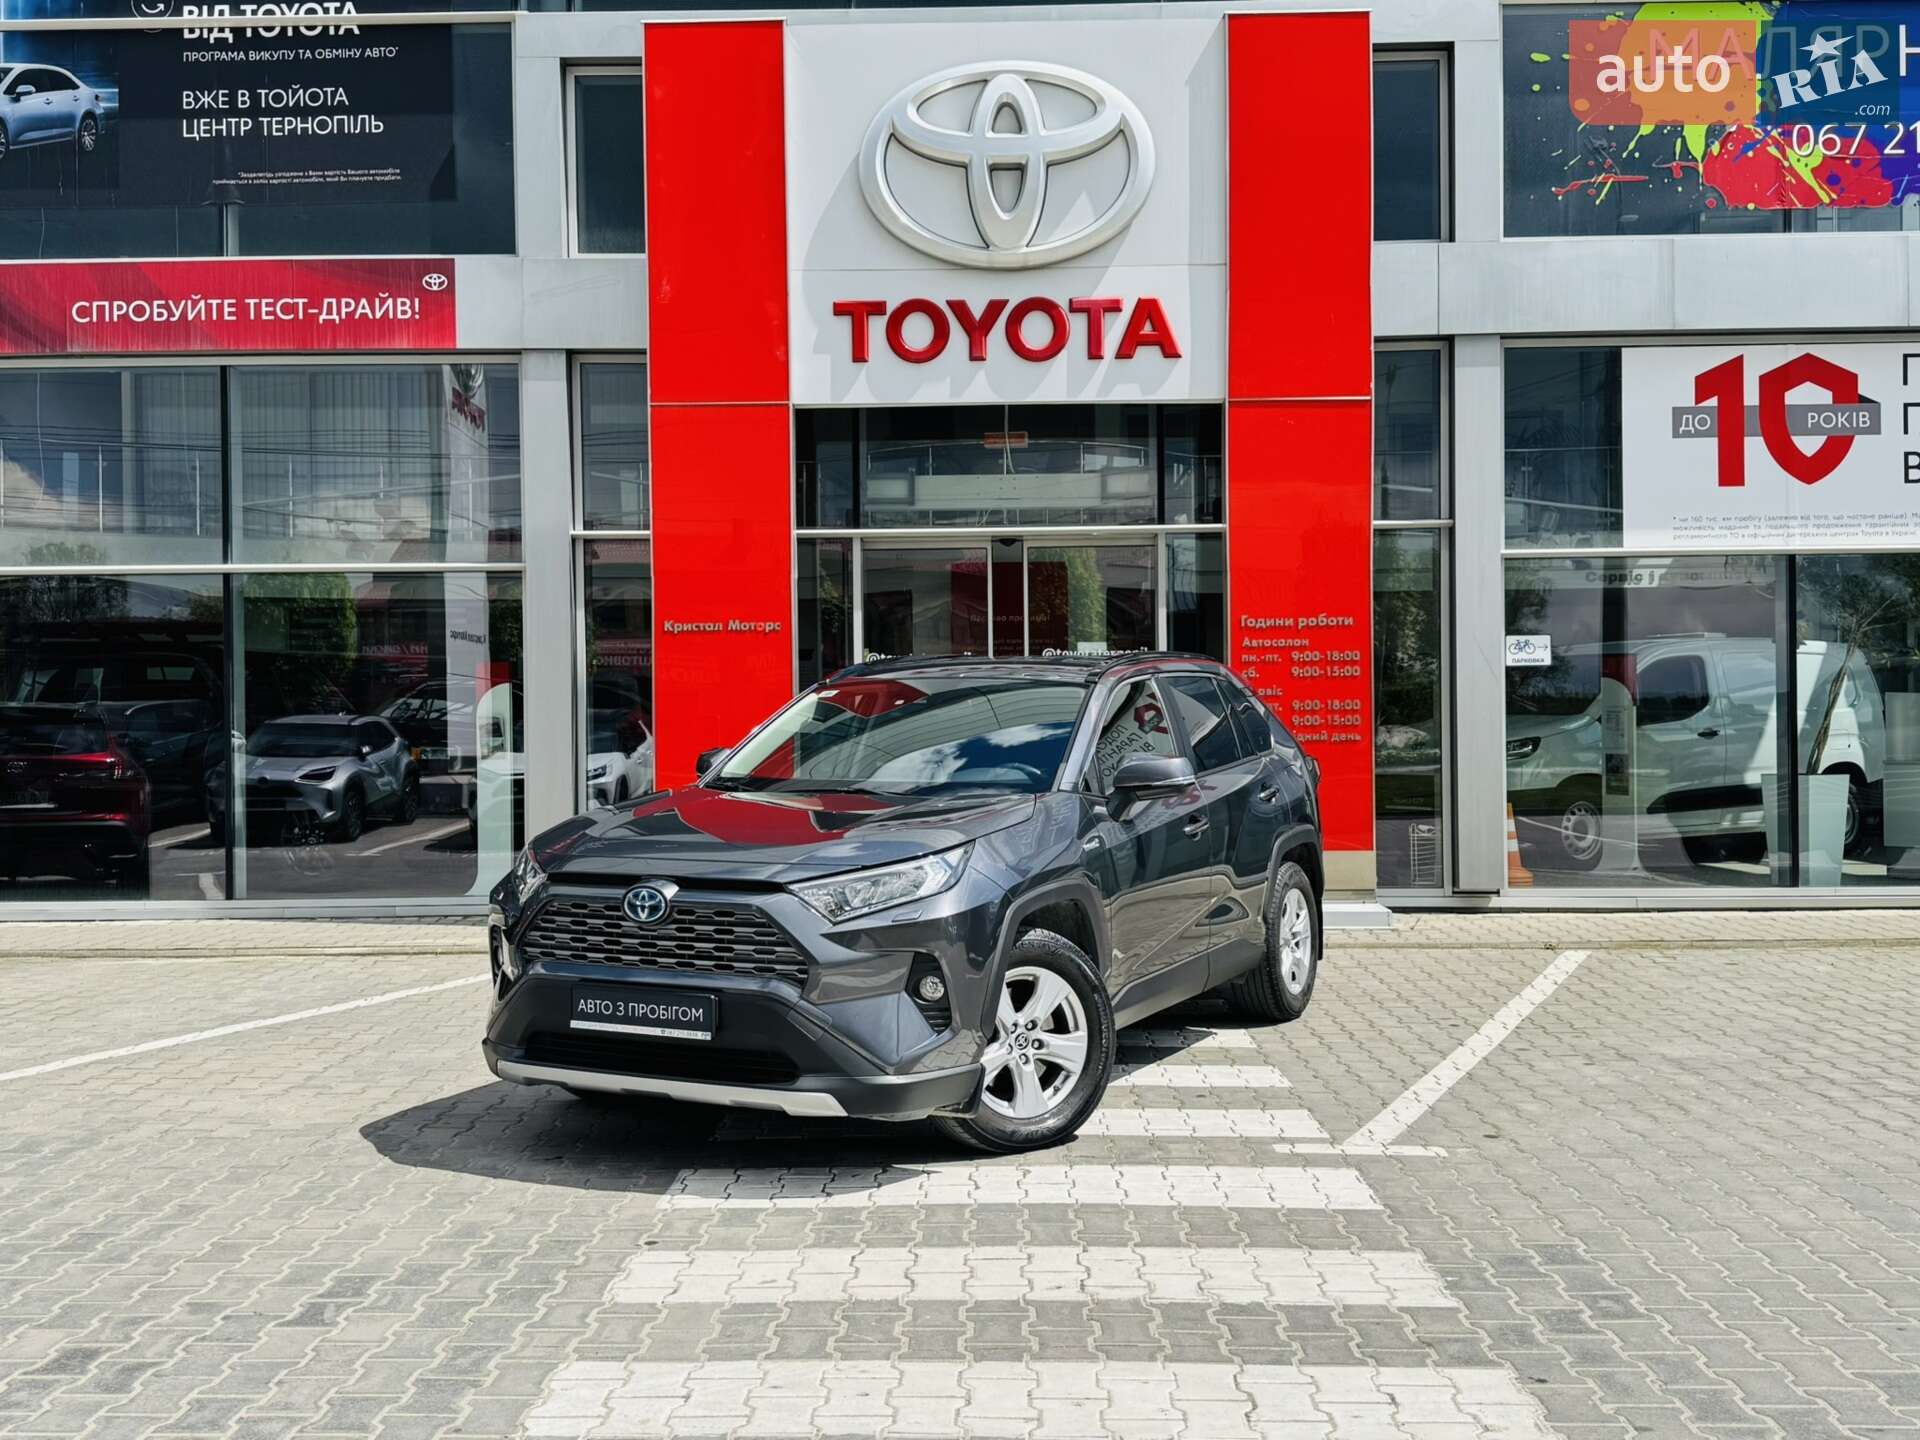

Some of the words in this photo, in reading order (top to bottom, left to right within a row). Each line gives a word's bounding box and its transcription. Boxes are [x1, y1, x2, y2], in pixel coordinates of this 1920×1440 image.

[182, 5, 233, 43] ВІД
[240, 2, 360, 37] TOYOTA
[183, 51, 246, 62] ПРОГРАМА
[249, 50, 296, 61] ВИКУПУ
[299, 49, 312, 60] ТА
[315, 48, 361, 59] ОБМІНУ
[183, 90, 229, 109] ВЖЕ
[238, 89, 250, 108] В
[257, 84, 349, 108] ТОЙОТА
[183, 118, 252, 141] ЦЕНТР
[259, 115, 384, 136] ТЕРНОПІЛЬ
[1792, 122, 1868, 156] 067
[72, 294, 237, 323] СПРОБУЙТЕ
[245, 292, 421, 324] ТЕСТ-ДРАЙВ!
[833, 297, 1182, 363] TOYOTA
[1679, 414, 1711, 433] ДО
[1695, 352, 1860, 487] 10
[1807, 412, 1871, 429] РОКІВ
[664, 620, 723, 634] Кристал
[728, 619, 782, 633] Моторс
[1240, 615, 1294, 628] Години
[1298, 613, 1354, 630] роботи
[1242, 636, 1310, 648] Автосалон
[1291, 650, 1361, 662] 9:00-18:00
[1291, 666, 1361, 677] 9:00-15:00
[1291, 700, 1361, 711] 9:00-18:00
[1291, 715, 1361, 726] 9:00-15:00
[1331, 732, 1361, 743] день
[577, 999, 613, 1015] АВТО
[616, 1002, 625, 1016] З
[628, 1002, 704, 1022] ПРОБІГОМ
